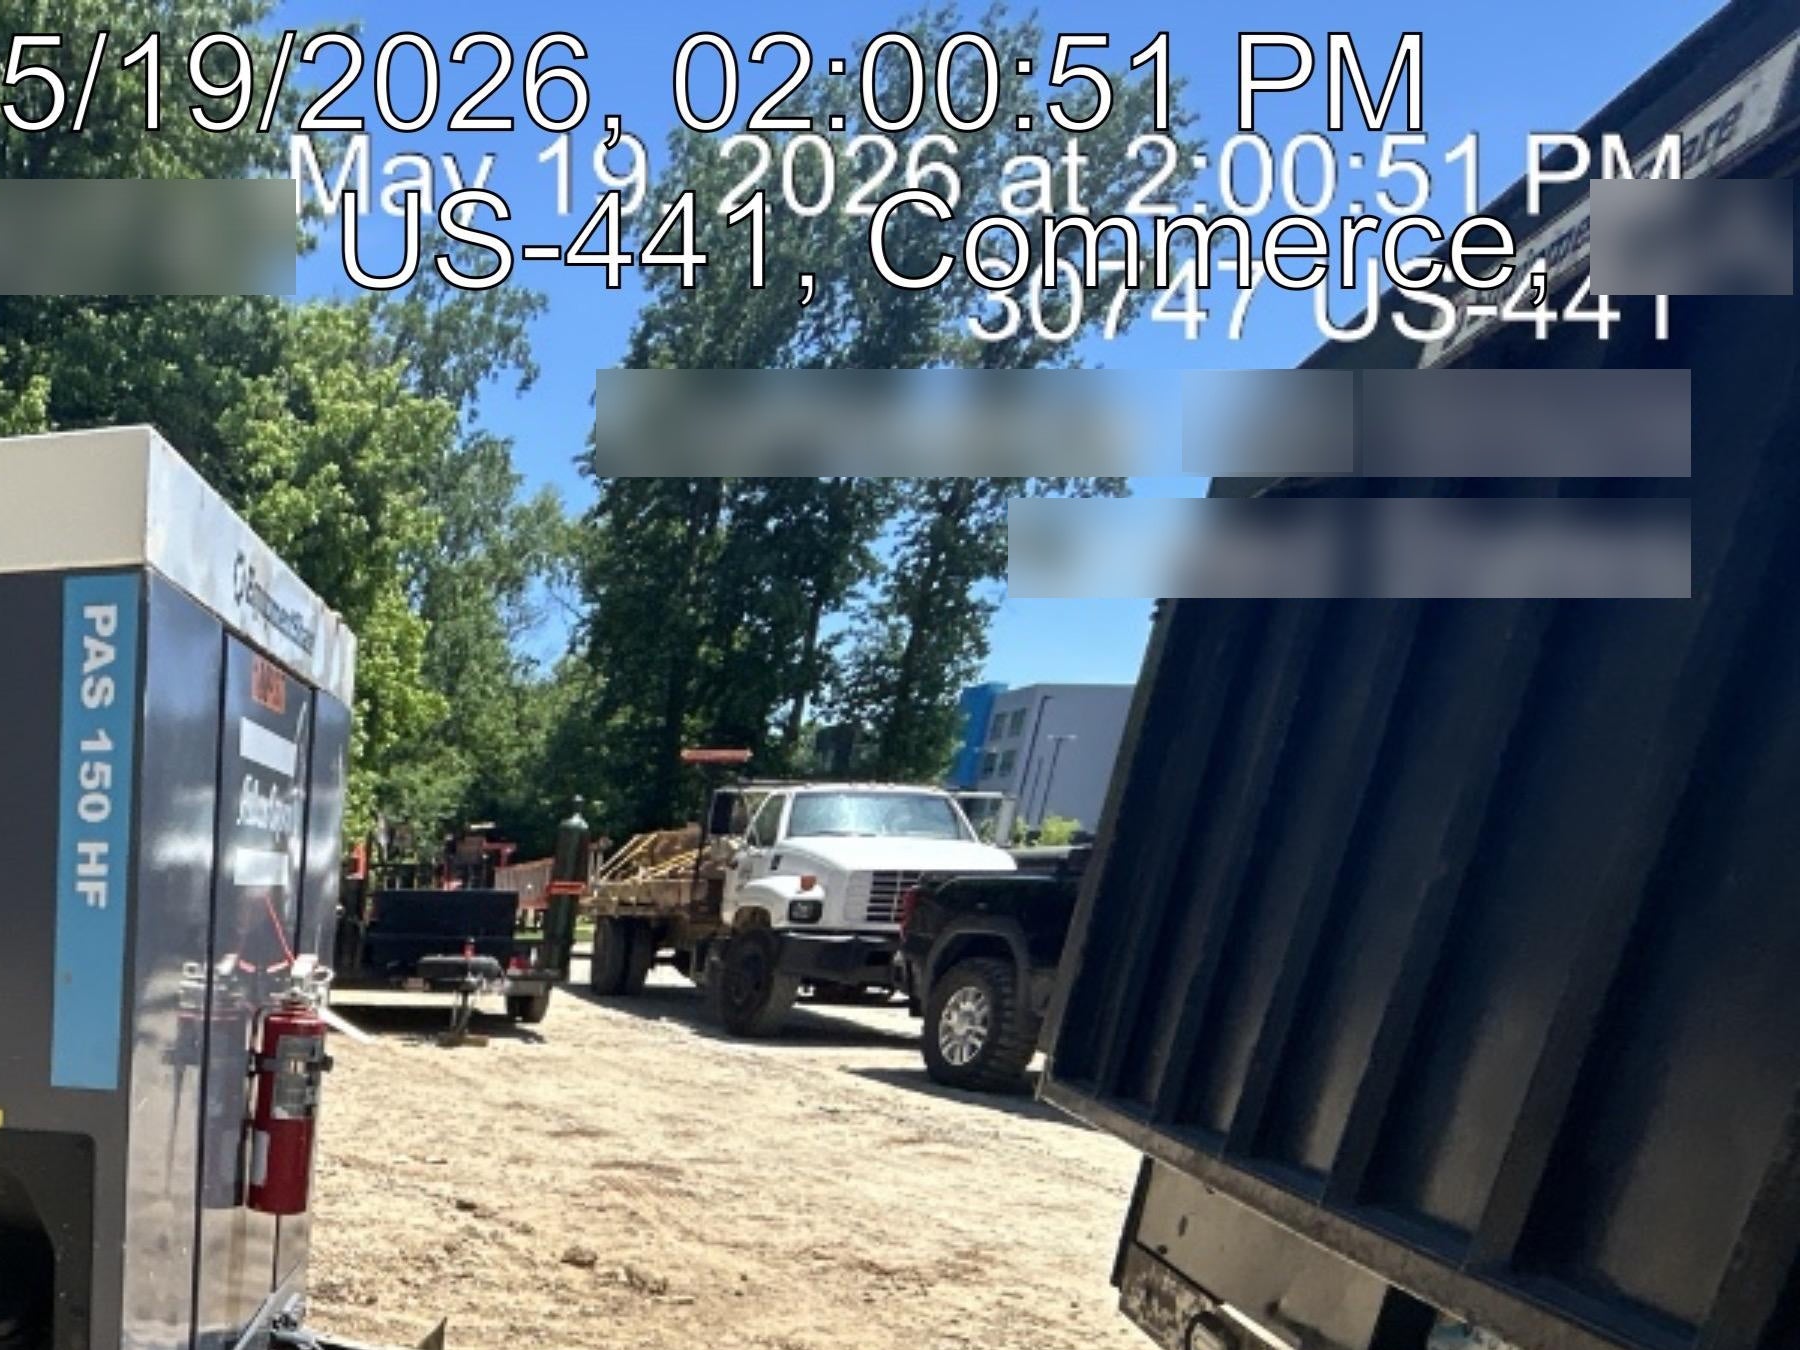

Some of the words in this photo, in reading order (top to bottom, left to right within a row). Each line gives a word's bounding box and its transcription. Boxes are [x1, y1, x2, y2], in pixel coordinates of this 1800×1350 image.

[81, 602, 118, 711] PAS
[77, 728, 115, 824] 150
[74, 842, 110, 910] HF
